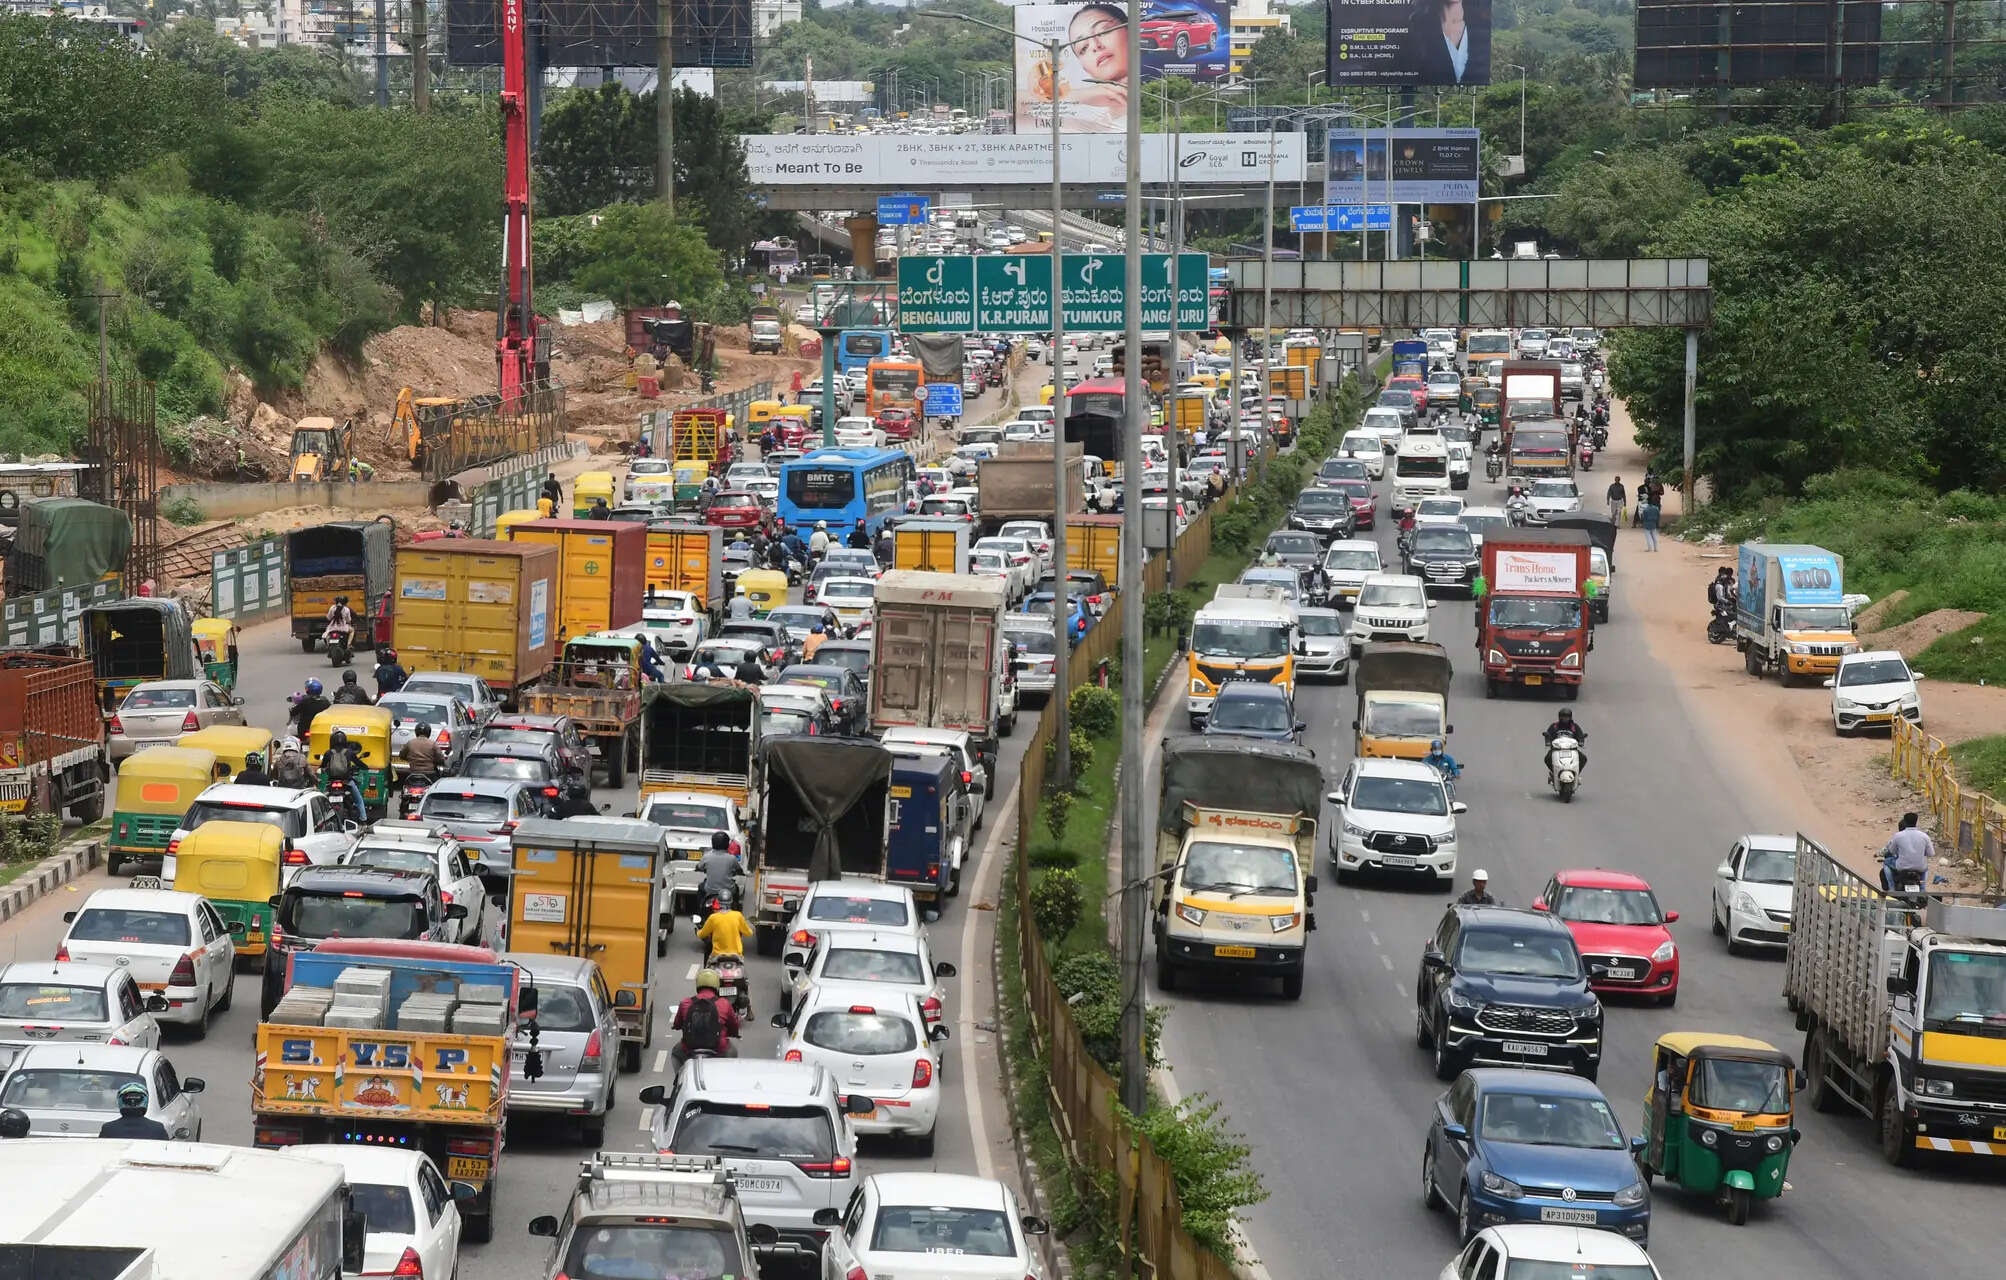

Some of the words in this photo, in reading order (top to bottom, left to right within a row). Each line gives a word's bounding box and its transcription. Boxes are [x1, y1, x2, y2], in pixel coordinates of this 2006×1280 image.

[507, 0, 517, 34] SANY
[981, 143, 1007, 152] 3BHK
[1008, 143, 1073, 152] APARTMETS
[775, 162, 820, 174] Meant
[823, 163, 841, 174] To
[844, 163, 863, 174] Be
[901, 310, 971, 325] BENGALURU
[981, 310, 1049, 325] K.R.PURAM
[1062, 310, 1123, 324] TUMKUR
[806, 473, 835, 482] BMTC
[131, 881, 159, 889] TAXI
[925, 1246, 964, 1255] UBER
